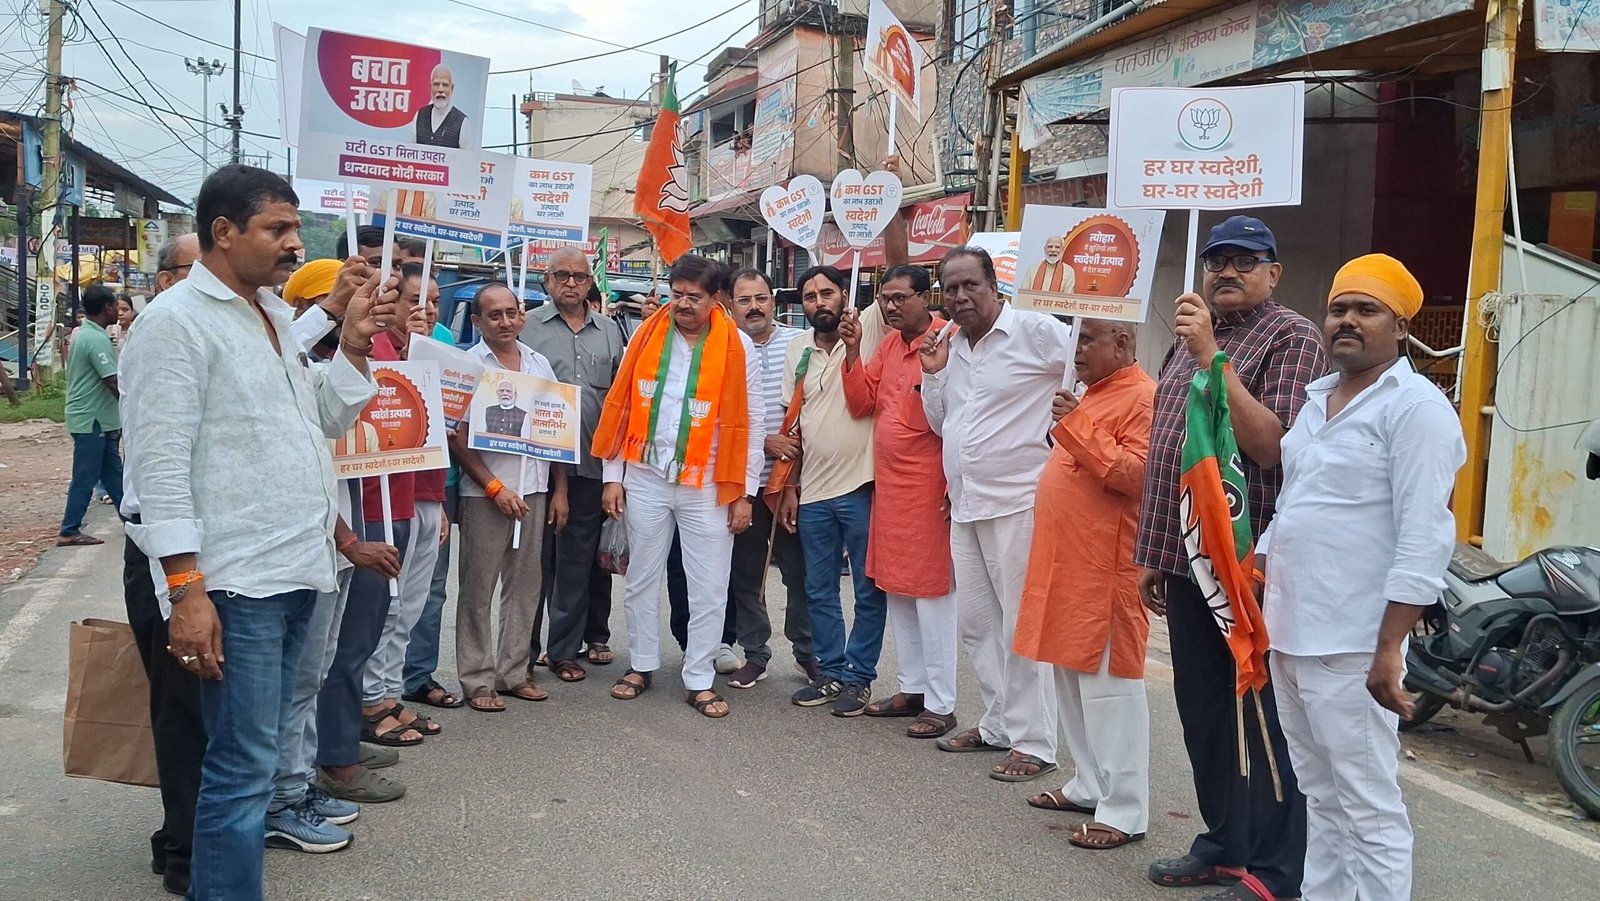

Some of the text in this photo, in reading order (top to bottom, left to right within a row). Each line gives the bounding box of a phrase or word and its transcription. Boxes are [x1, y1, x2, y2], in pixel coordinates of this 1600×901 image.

[1115, 36, 1173, 75] पतंजलि
[351, 55, 410, 85] बचत
[350, 86, 411, 113] उत्सव
[345, 140, 446, 163] घटी GST मिला उपहार
[344, 161, 445, 182] धन्यवाद मोदी सरकार
[480, 162, 495, 174] ST
[1143, 154, 1263, 176] हर घर स्वदेशी,
[529, 169, 575, 182] कम GST
[845, 184, 884, 195] कम GST
[1142, 178, 1264, 200] घर-घर स्वदेशी
[453, 200, 475, 209] उत्पाद
[532, 191, 569, 204] स्वदेशी
[774, 188, 807, 209] कम GST
[449, 208, 480, 218] घर लाओ
[549, 210, 564, 218] लाओ
[787, 209, 812, 230] स्वदेशी
[845, 208, 878, 221] स्वदेशी
[402, 222, 413, 231] घर
[459, 231, 483, 242] स्वदेशी
[1089, 231, 1116, 243] त्योहार
[1073, 253, 1125, 266] स्वदेशी उत्पाद
[1033, 298, 1041, 307] हर
[1043, 300, 1053, 308] घर
[1079, 303, 1100, 312] घर-घर
[1101, 302, 1123, 314] स्वदेशी
[389, 408, 412, 418] उत्पाद
[534, 408, 563, 419] भारत को
[532, 418, 567, 430] आत्मनिर्भर
[489, 439, 497, 447] हर
[542, 449, 561, 457] स्वदेशी
[340, 464, 350, 473] हर
[352, 463, 362, 471] घर
[402, 454, 425, 465] स्वदेशी
